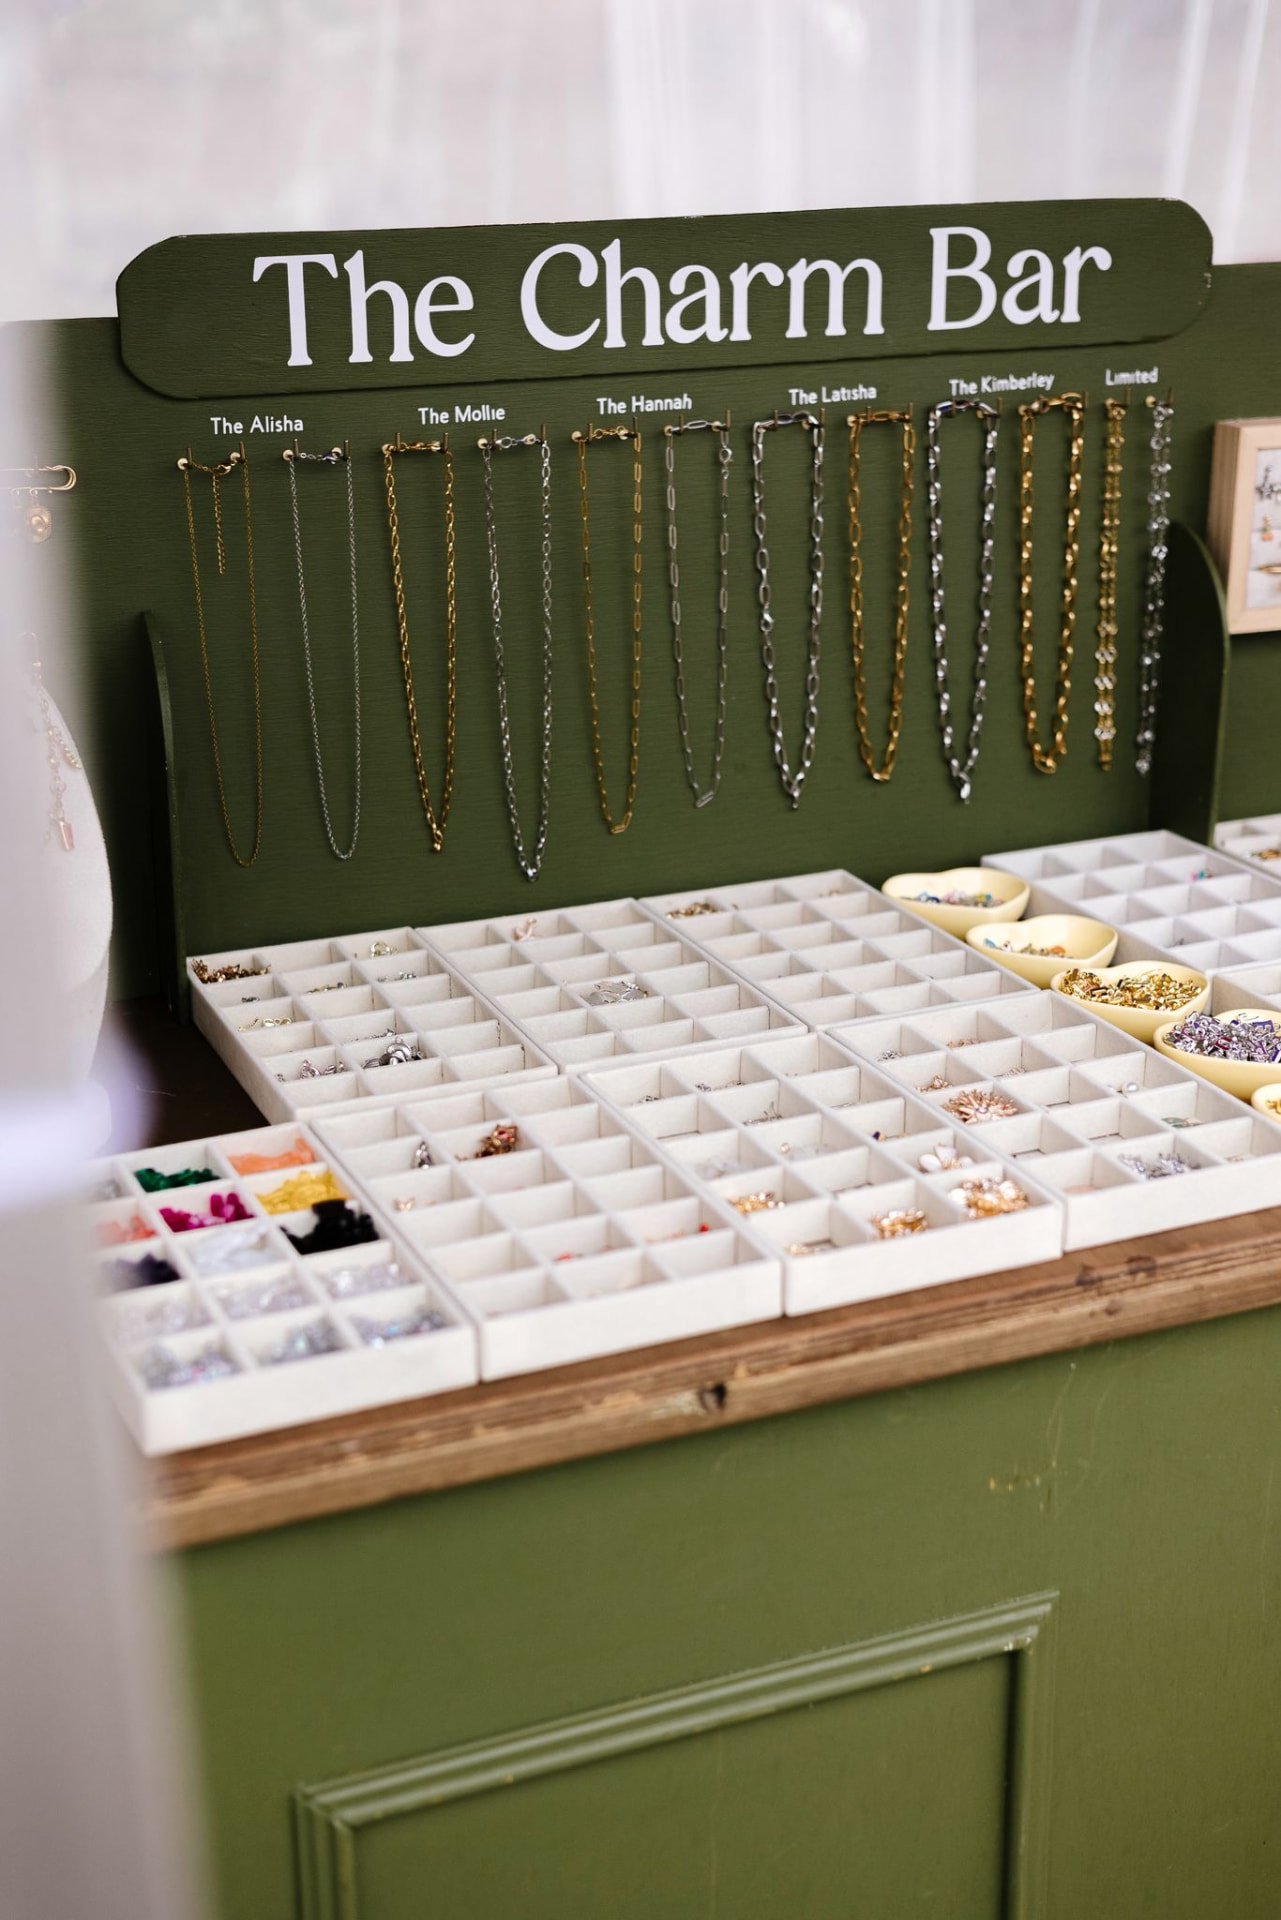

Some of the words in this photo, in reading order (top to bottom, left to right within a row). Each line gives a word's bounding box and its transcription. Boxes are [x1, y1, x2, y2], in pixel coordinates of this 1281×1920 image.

[252, 250, 475, 367] The
[520, 239, 885, 351] Charm
[927, 227, 1113, 331] Bar
[788, 388, 818, 406] The
[821, 383, 877, 403] Latisha
[948, 378, 978, 397] The
[980, 372, 1055, 393] Kimberley
[417, 407, 450, 425] The
[454, 404, 506, 423] Mollie
[596, 397, 627, 415] The
[631, 392, 693, 413] Hannah
[210, 416, 244, 435] The
[250, 415, 304, 434] Alisha
